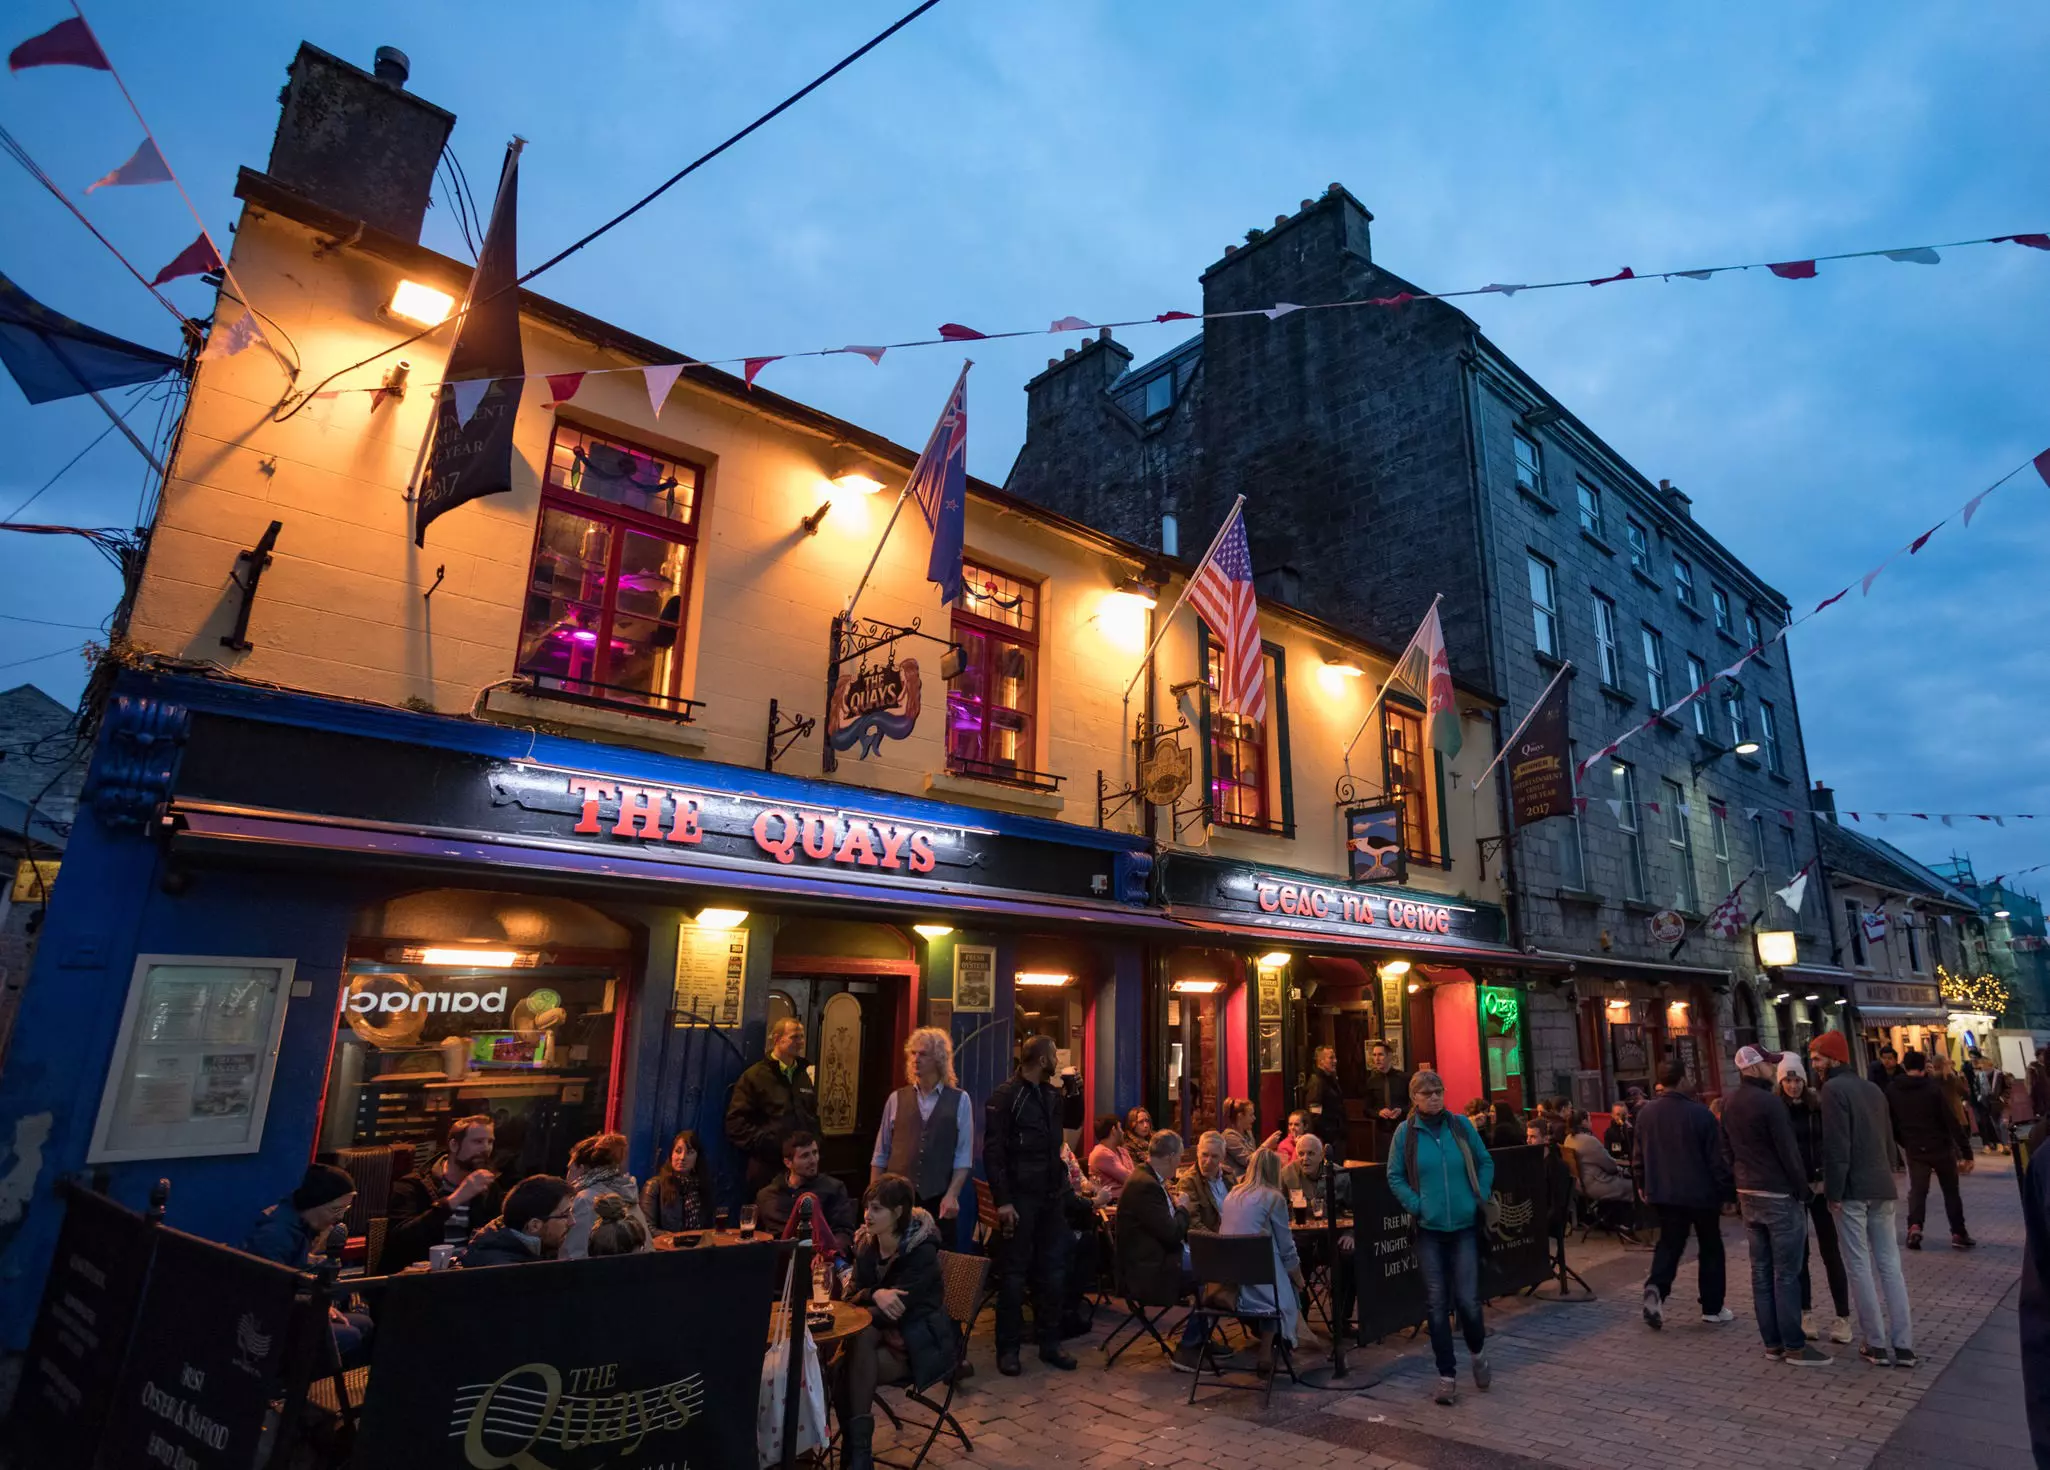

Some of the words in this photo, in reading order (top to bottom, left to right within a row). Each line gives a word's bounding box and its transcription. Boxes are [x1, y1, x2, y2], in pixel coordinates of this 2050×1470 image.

[423, 471, 461, 508] 2017
[864, 674, 885, 690] THE
[850, 683, 897, 711] QUAYS
[1526, 803, 1550, 817] 2017
[568, 776, 706, 846] THE
[752, 807, 938, 874] QUAYS
[1383, 1215, 1400, 1231] FREE
[1373, 1241, 1380, 1257] 7
[1384, 1260, 1400, 1277] LATE
[569, 1361, 620, 1395] THE
[464, 1362, 692, 1470] Quays
